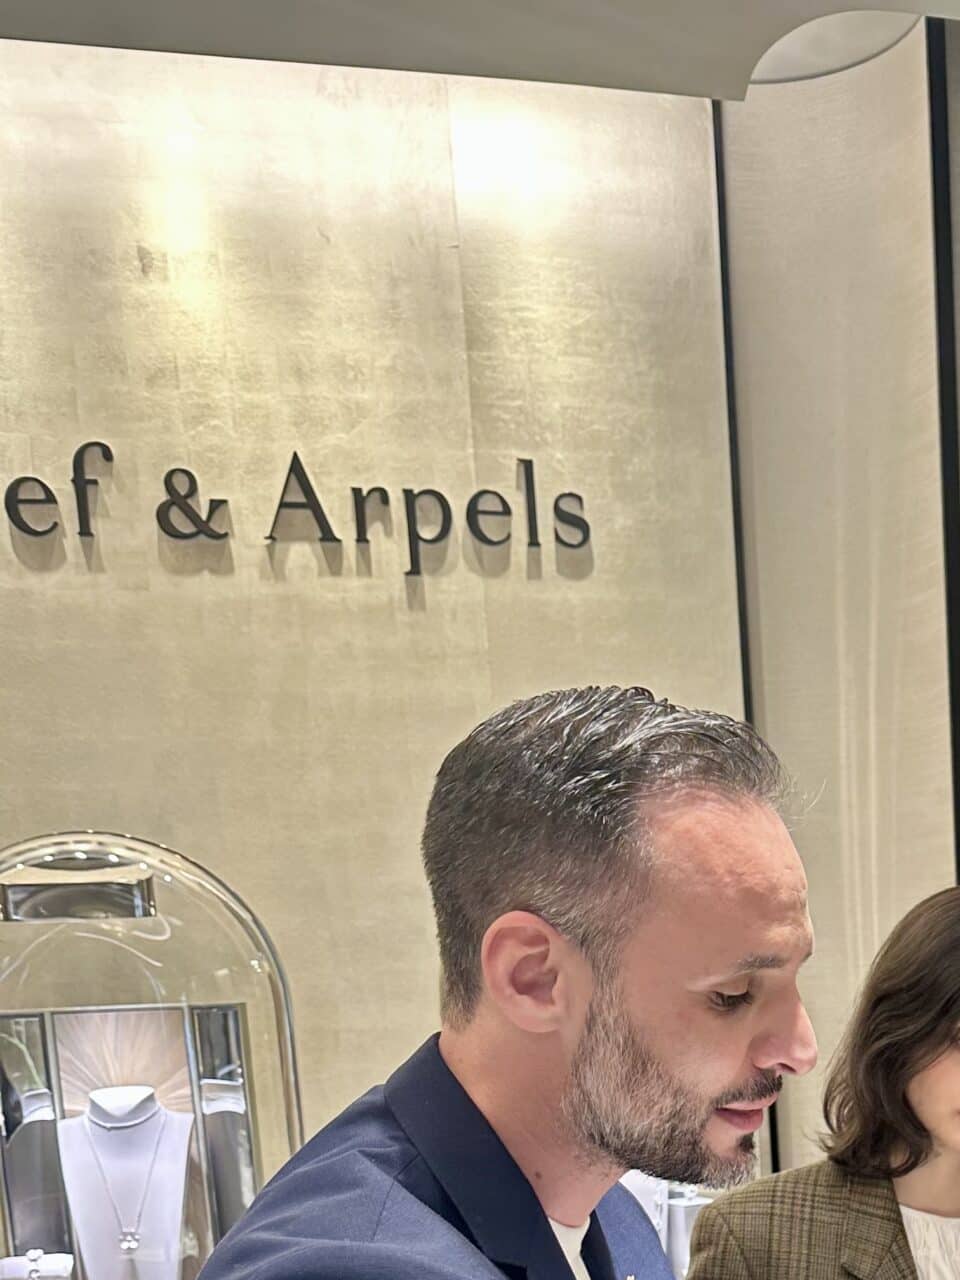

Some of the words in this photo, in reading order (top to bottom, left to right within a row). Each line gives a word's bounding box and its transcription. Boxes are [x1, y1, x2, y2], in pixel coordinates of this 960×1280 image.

[3, 440, 114, 537] ef
[156, 468, 229, 540] &
[264, 451, 591, 576] Arpels
